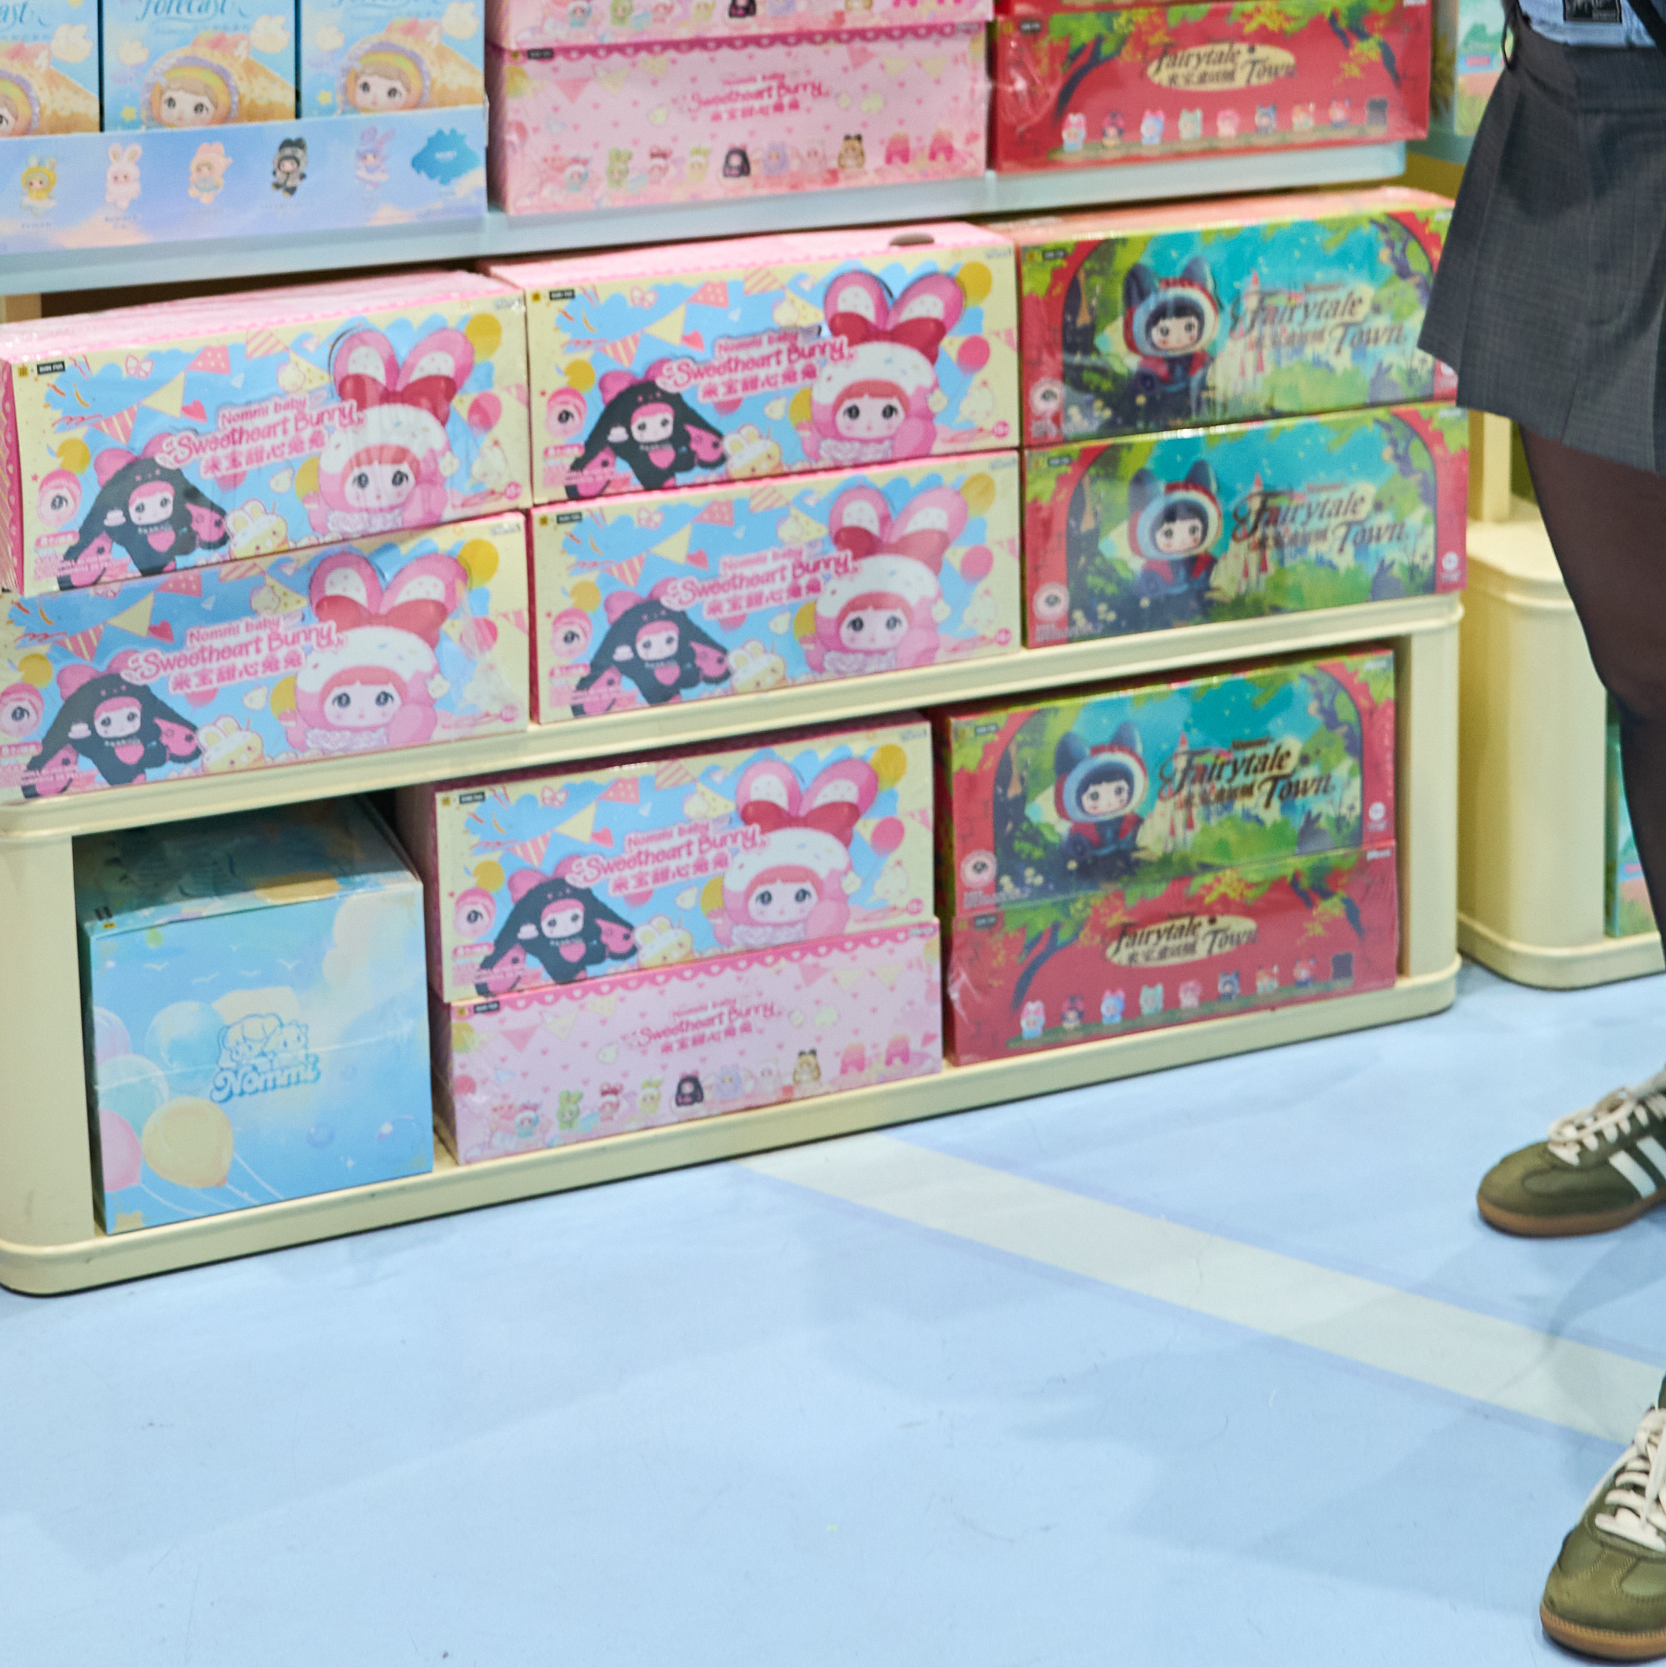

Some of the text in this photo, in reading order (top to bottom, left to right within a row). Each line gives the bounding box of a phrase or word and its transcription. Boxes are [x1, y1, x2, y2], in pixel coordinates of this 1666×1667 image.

[674, 338, 846, 388] Sweetheart Bunny
[173, 402, 357, 465] Sweetheart Bunny
[220, 397, 307, 425] Nommi baby
[1334, 520, 1406, 556] Town
[140, 622, 334, 681] Sweetheart Bunny
[189, 616, 281, 644] Nommi baby
[1158, 743, 1292, 801] Fairytale
[1258, 773, 1332, 810] Town
[583, 828, 761, 884] Sweetheart Bunny
[1202, 928, 1259, 956] Town
[210, 1052, 321, 1104] Nommi
